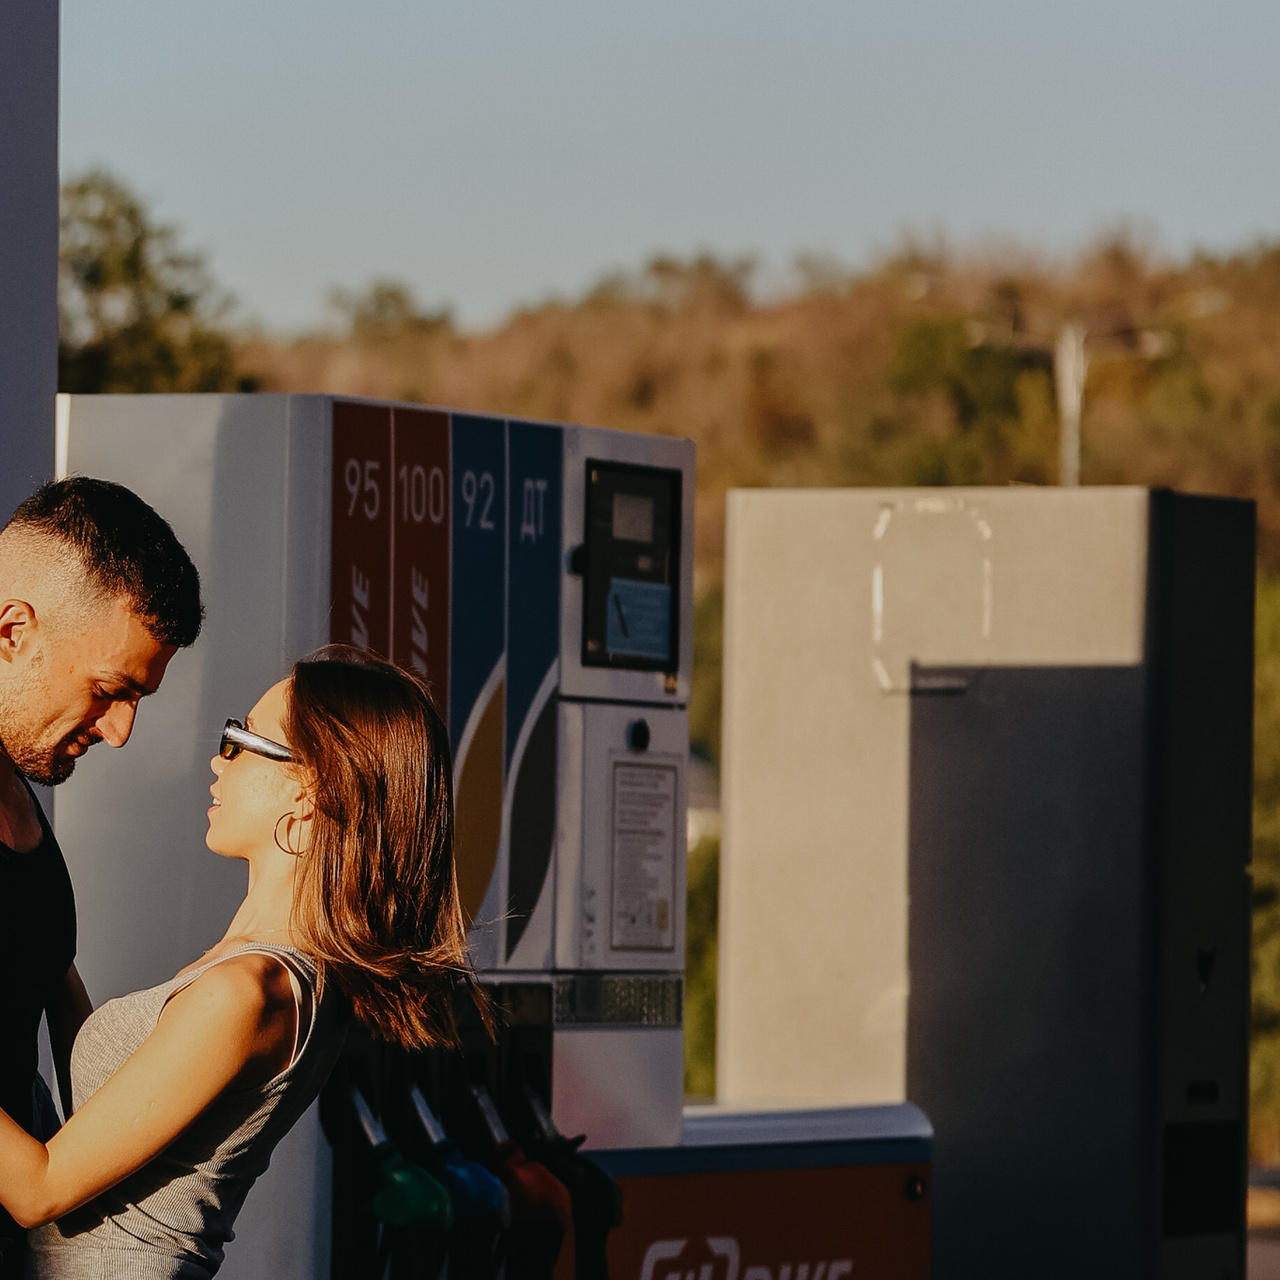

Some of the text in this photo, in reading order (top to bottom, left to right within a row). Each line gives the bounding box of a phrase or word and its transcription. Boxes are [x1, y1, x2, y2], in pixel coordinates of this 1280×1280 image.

[345, 457, 380, 521] 95
[398, 464, 445, 525] 100
[461, 470, 495, 531] 92
[520, 476, 549, 544] ДТ
